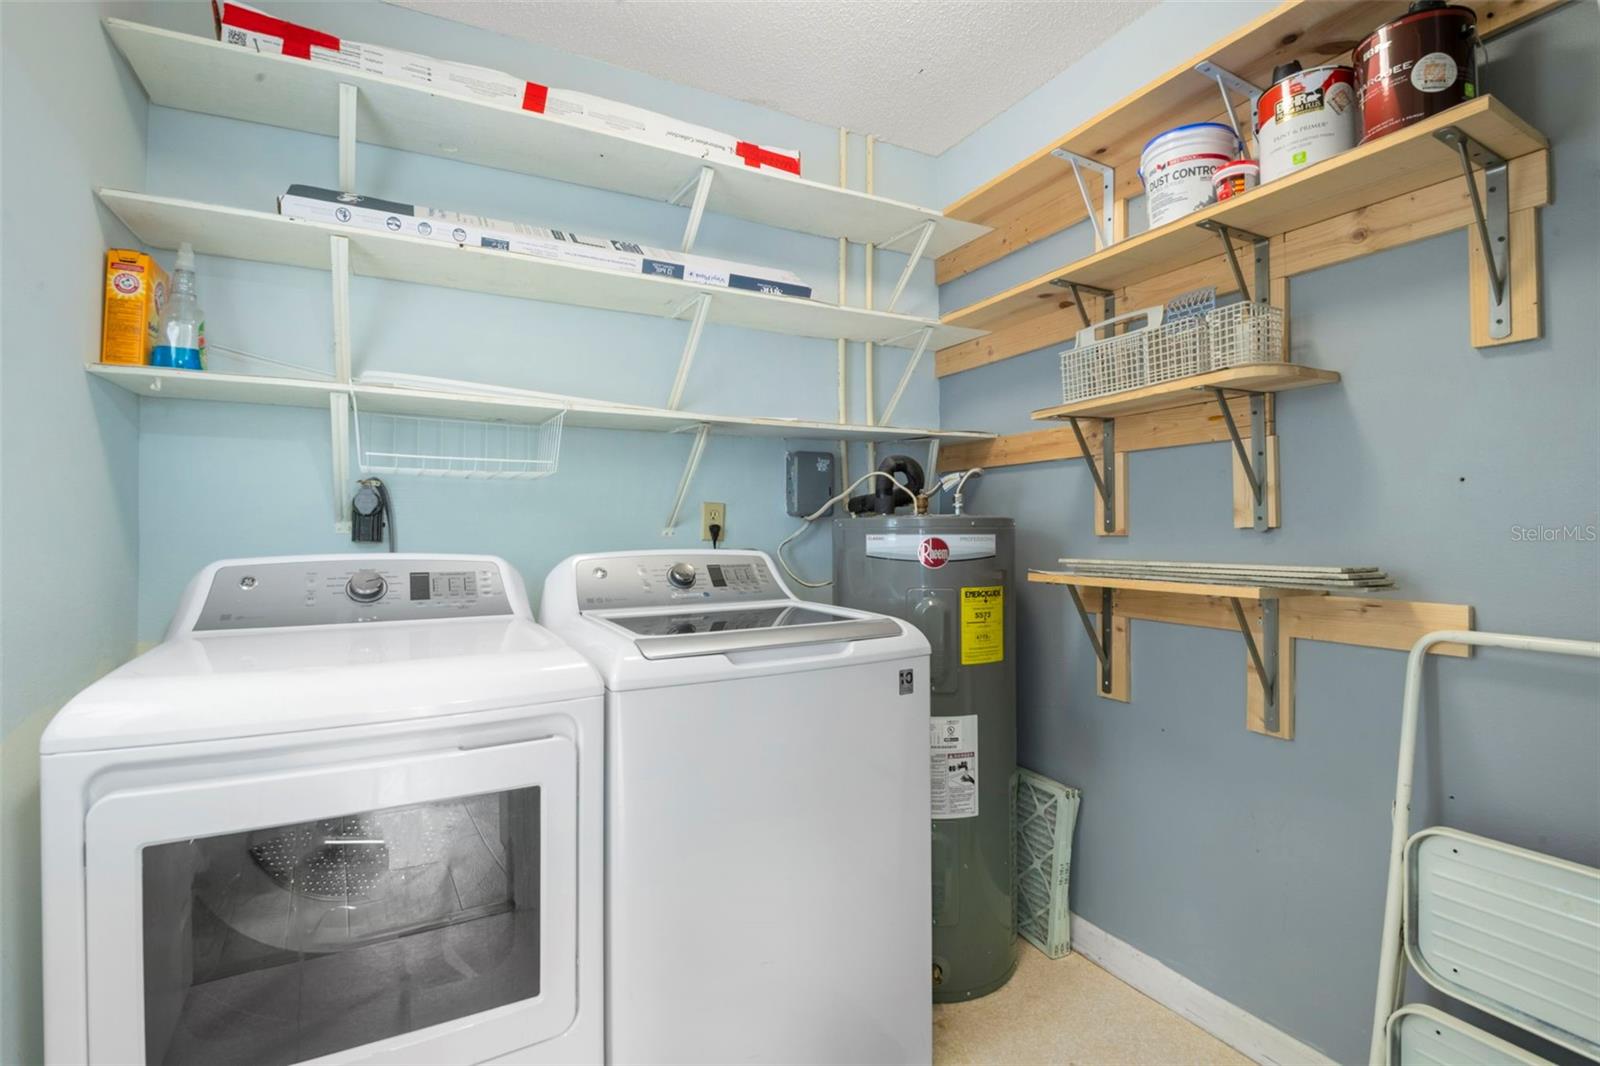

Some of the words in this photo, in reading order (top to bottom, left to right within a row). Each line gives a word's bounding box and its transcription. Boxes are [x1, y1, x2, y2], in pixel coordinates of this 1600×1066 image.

[1276, 94, 1307, 113] BHR
[1149, 173, 1170, 192] DUST
[1172, 164, 1218, 181] CONTRO
[921, 538, 949, 564] Rheem
